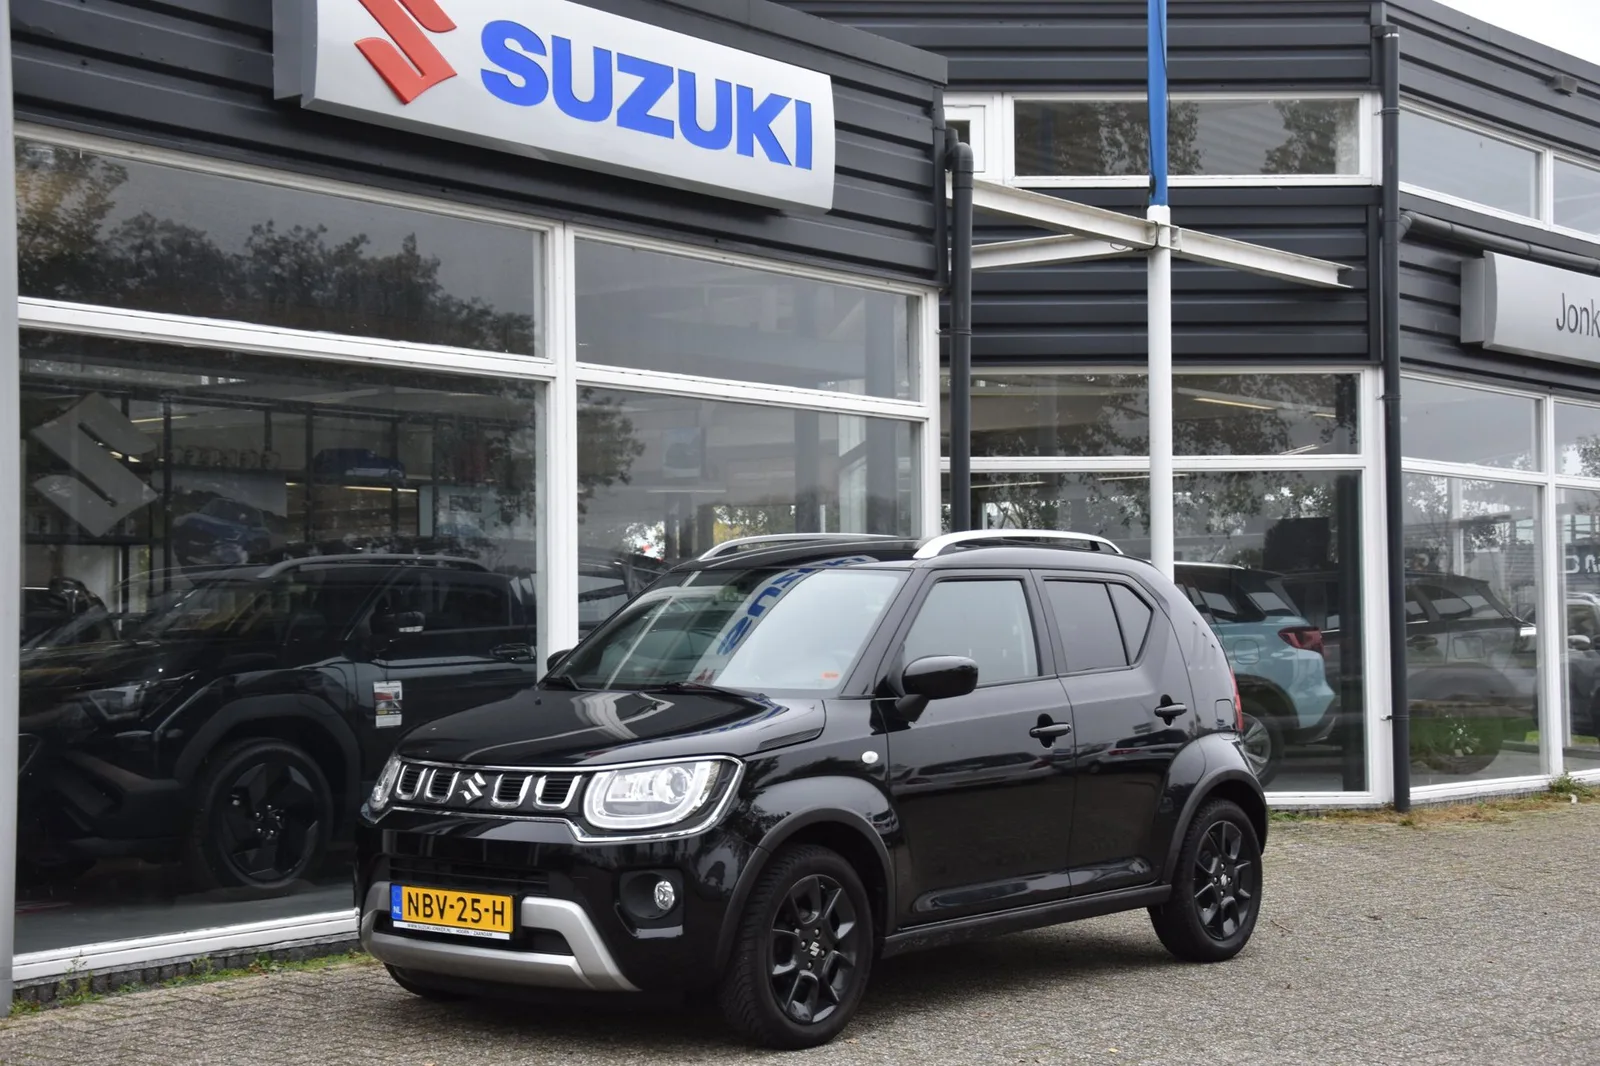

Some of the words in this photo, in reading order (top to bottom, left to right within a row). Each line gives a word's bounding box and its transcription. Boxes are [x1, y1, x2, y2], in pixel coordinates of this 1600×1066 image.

[480, 20, 812, 171] SUZUKI
[1556, 292, 1600, 338] Jonk
[393, 905, 402, 915] NL
[407, 891, 505, 927] NBV-25-H
